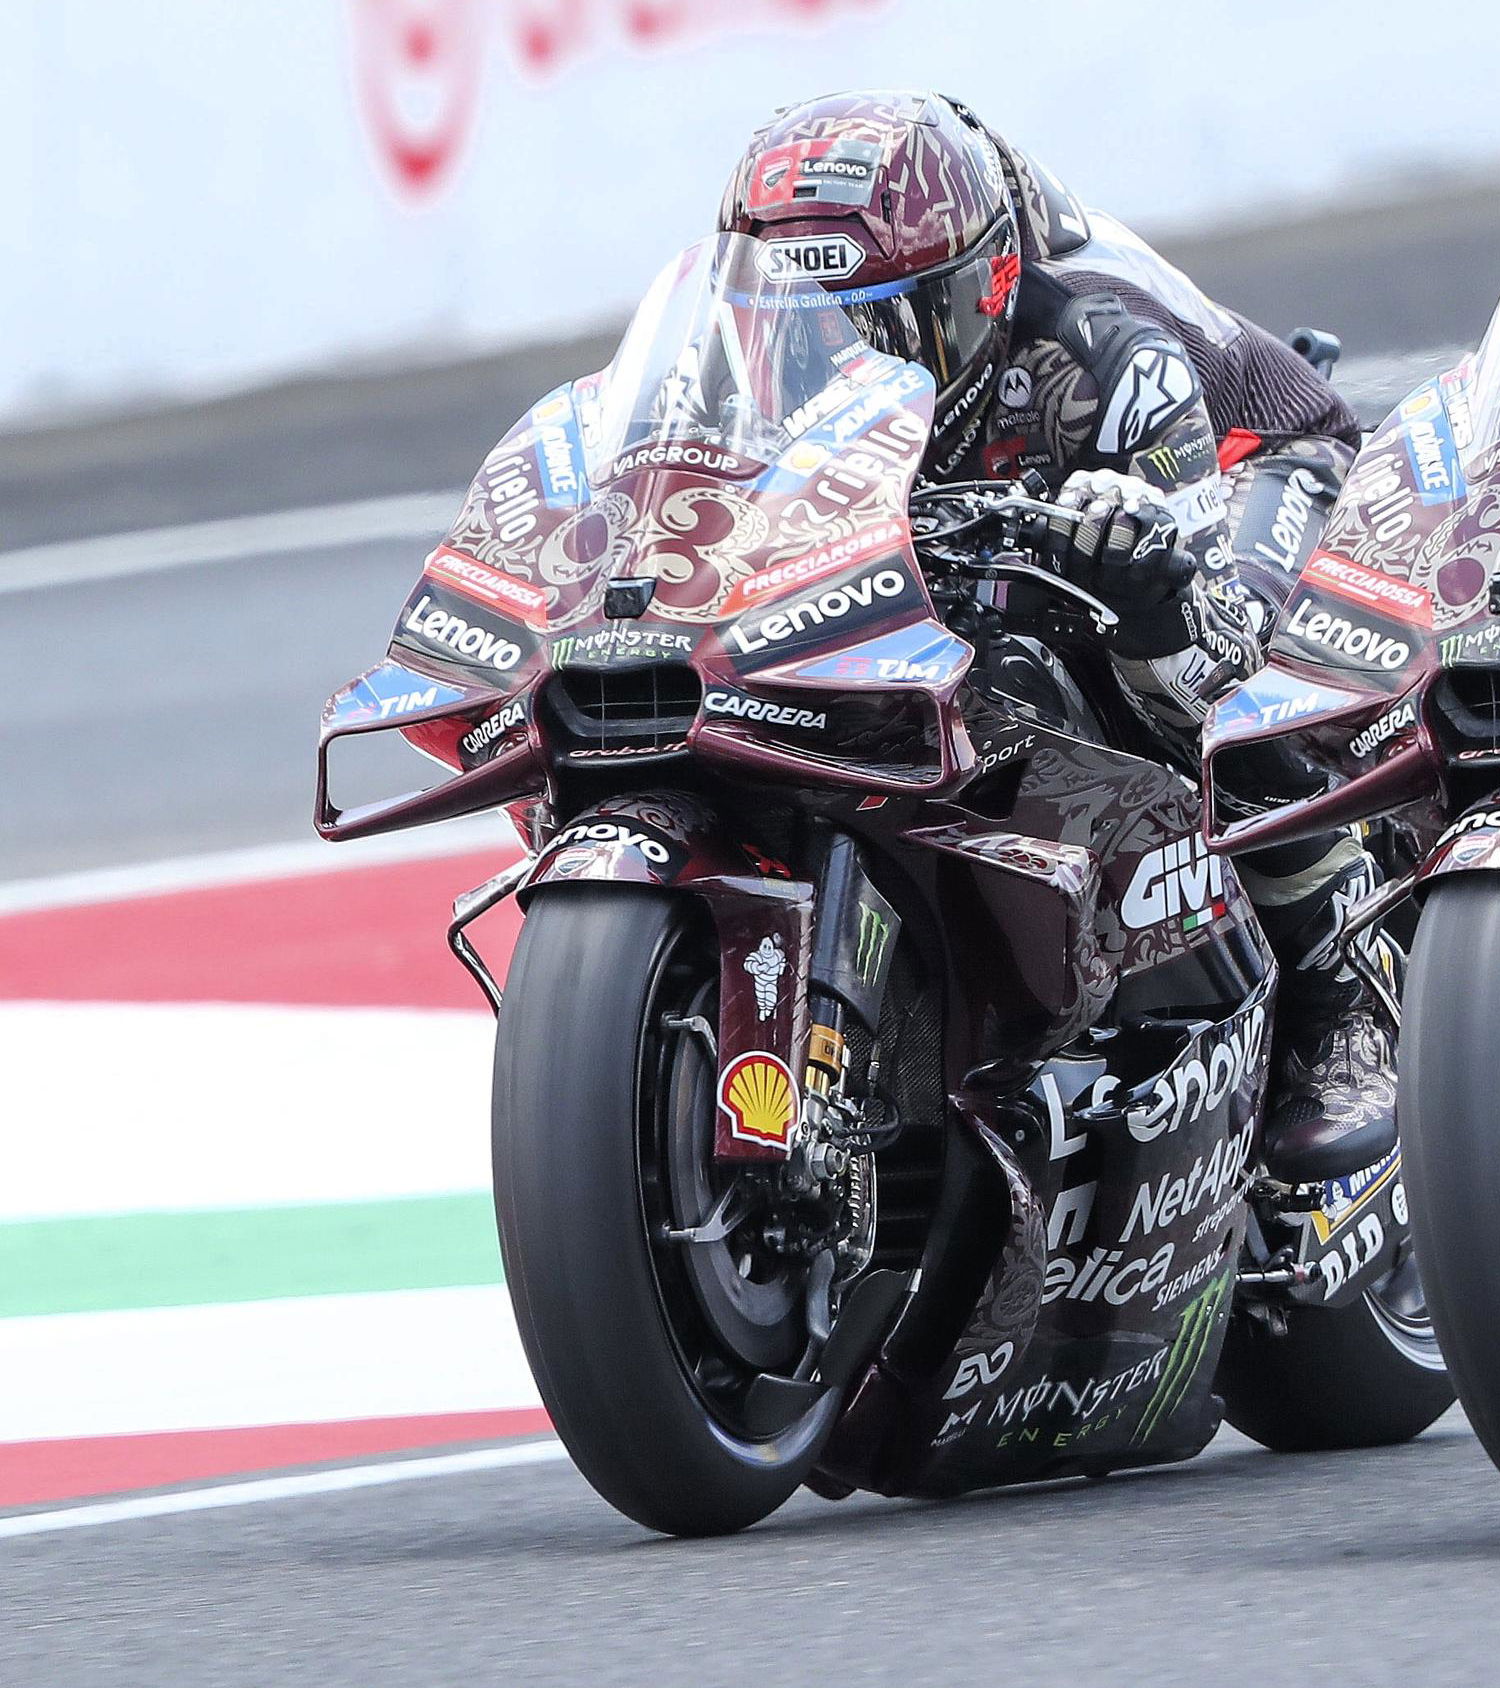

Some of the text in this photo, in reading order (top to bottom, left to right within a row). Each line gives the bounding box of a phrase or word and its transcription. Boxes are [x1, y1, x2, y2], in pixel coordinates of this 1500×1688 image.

[804, 160, 867, 177] Lenovo
[770, 243, 847, 274] SHOEI
[830, 340, 869, 366] MARQUEZ
[934, 362, 994, 438] Lenovo
[612, 446, 740, 476] VARGROUP
[815, 411, 928, 507] riello
[935, 417, 982, 475] Lenovo
[485, 454, 544, 544] riello
[1356, 452, 1416, 543] riello
[434, 554, 545, 607] FRECCIAROSSA
[742, 523, 904, 597] FRECCIAROSSA
[1311, 557, 1427, 609] FRECCIAROSSA
[406, 595, 521, 670] Lenovo
[729, 569, 906, 654] Lenovo
[1286, 598, 1410, 670] Lenovo
[574, 629, 692, 652] MONSTER
[588, 649, 672, 659] ENERGY
[875, 658, 940, 681] TIM
[379, 687, 438, 719] TIM
[462, 702, 526, 755] CARRERA
[704, 691, 827, 729] CARRERA
[1259, 693, 1319, 726] TIM
[1349, 703, 1416, 759] CARRERA
[978, 732, 1036, 775] port
[1121, 831, 1224, 929] GIVI
[1118, 1114, 1255, 1243] NetApp
[1041, 1242, 1176, 1306] elica
[1152, 1243, 1225, 1312] SIEMENS
[1319, 1212, 1385, 1301] D.I.D
[986, 1346, 1169, 1427] MONSTER
[996, 1404, 1128, 1448] ENERGY
